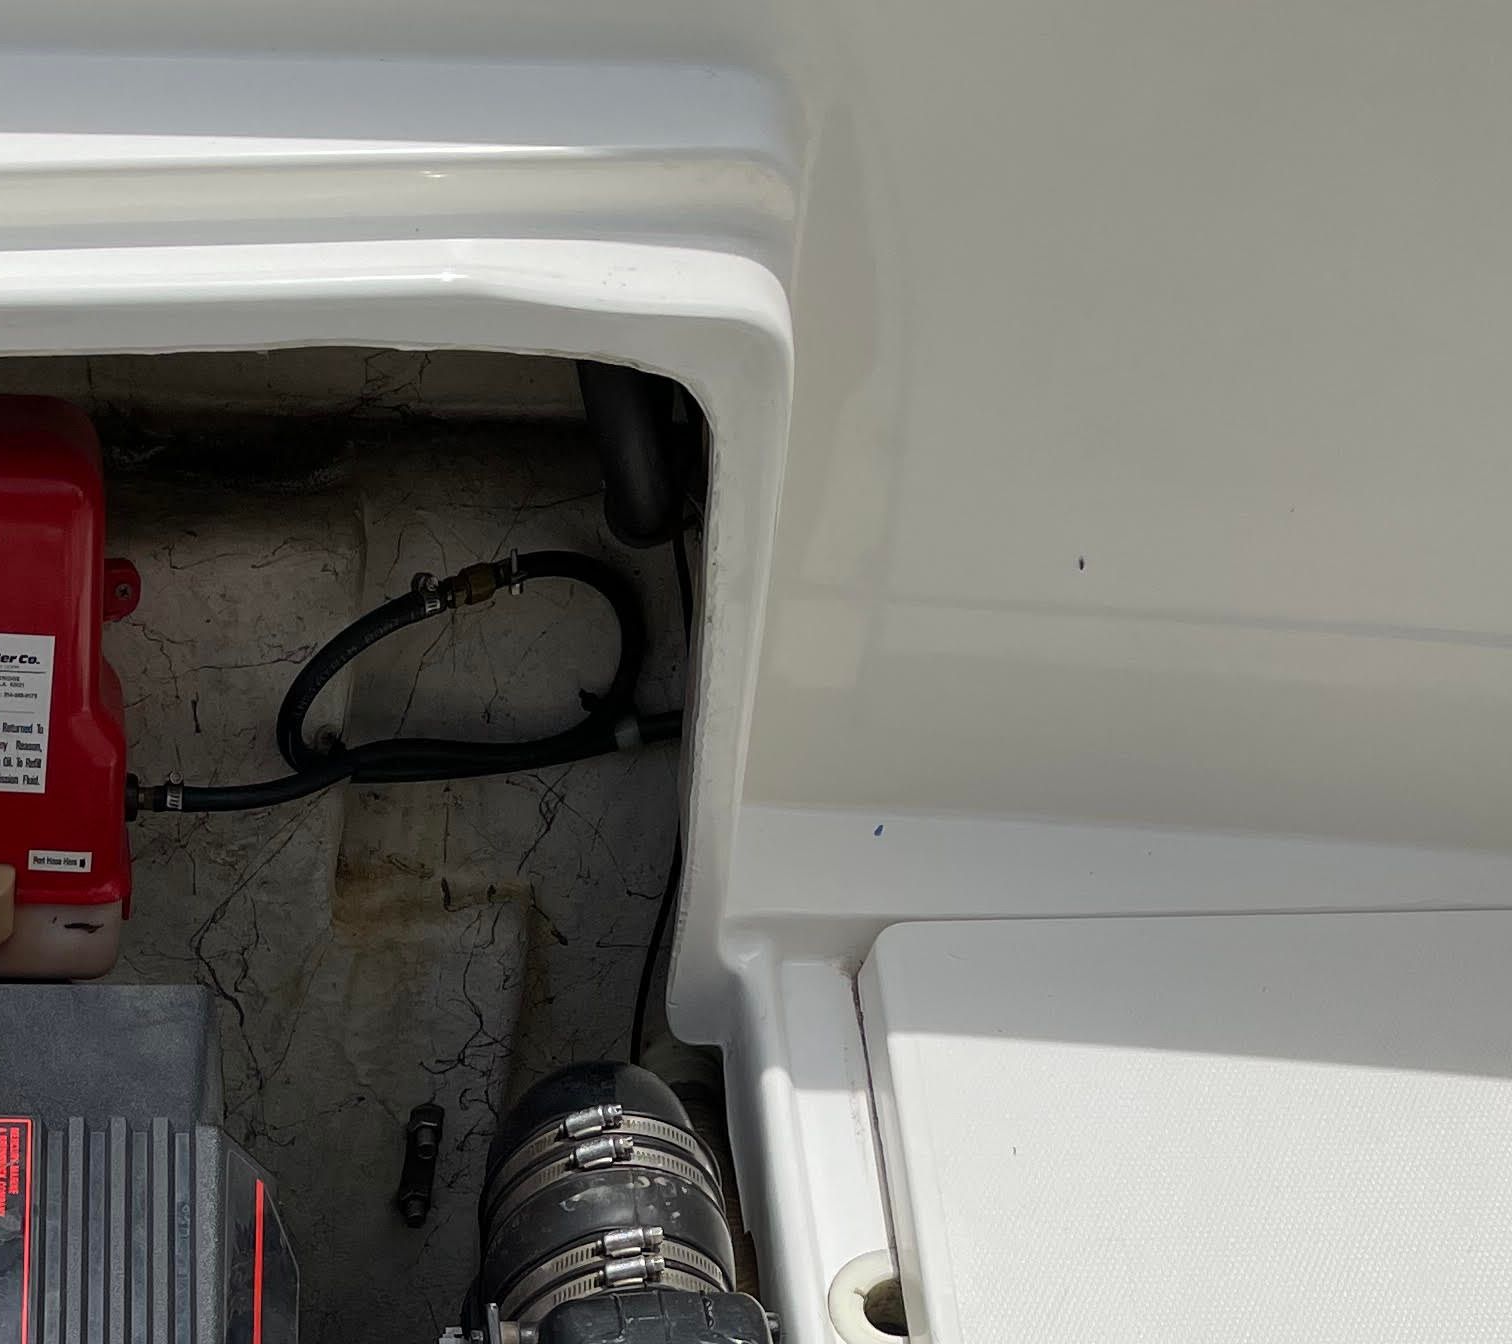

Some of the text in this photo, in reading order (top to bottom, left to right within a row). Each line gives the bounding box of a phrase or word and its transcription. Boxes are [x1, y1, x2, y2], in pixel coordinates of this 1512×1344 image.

[18, 654, 40, 665] Co.
[2, 722, 33, 734] Returned
[36, 723, 44, 734] To
[16, 757, 24, 768] To
[25, 757, 42, 768] Refill
